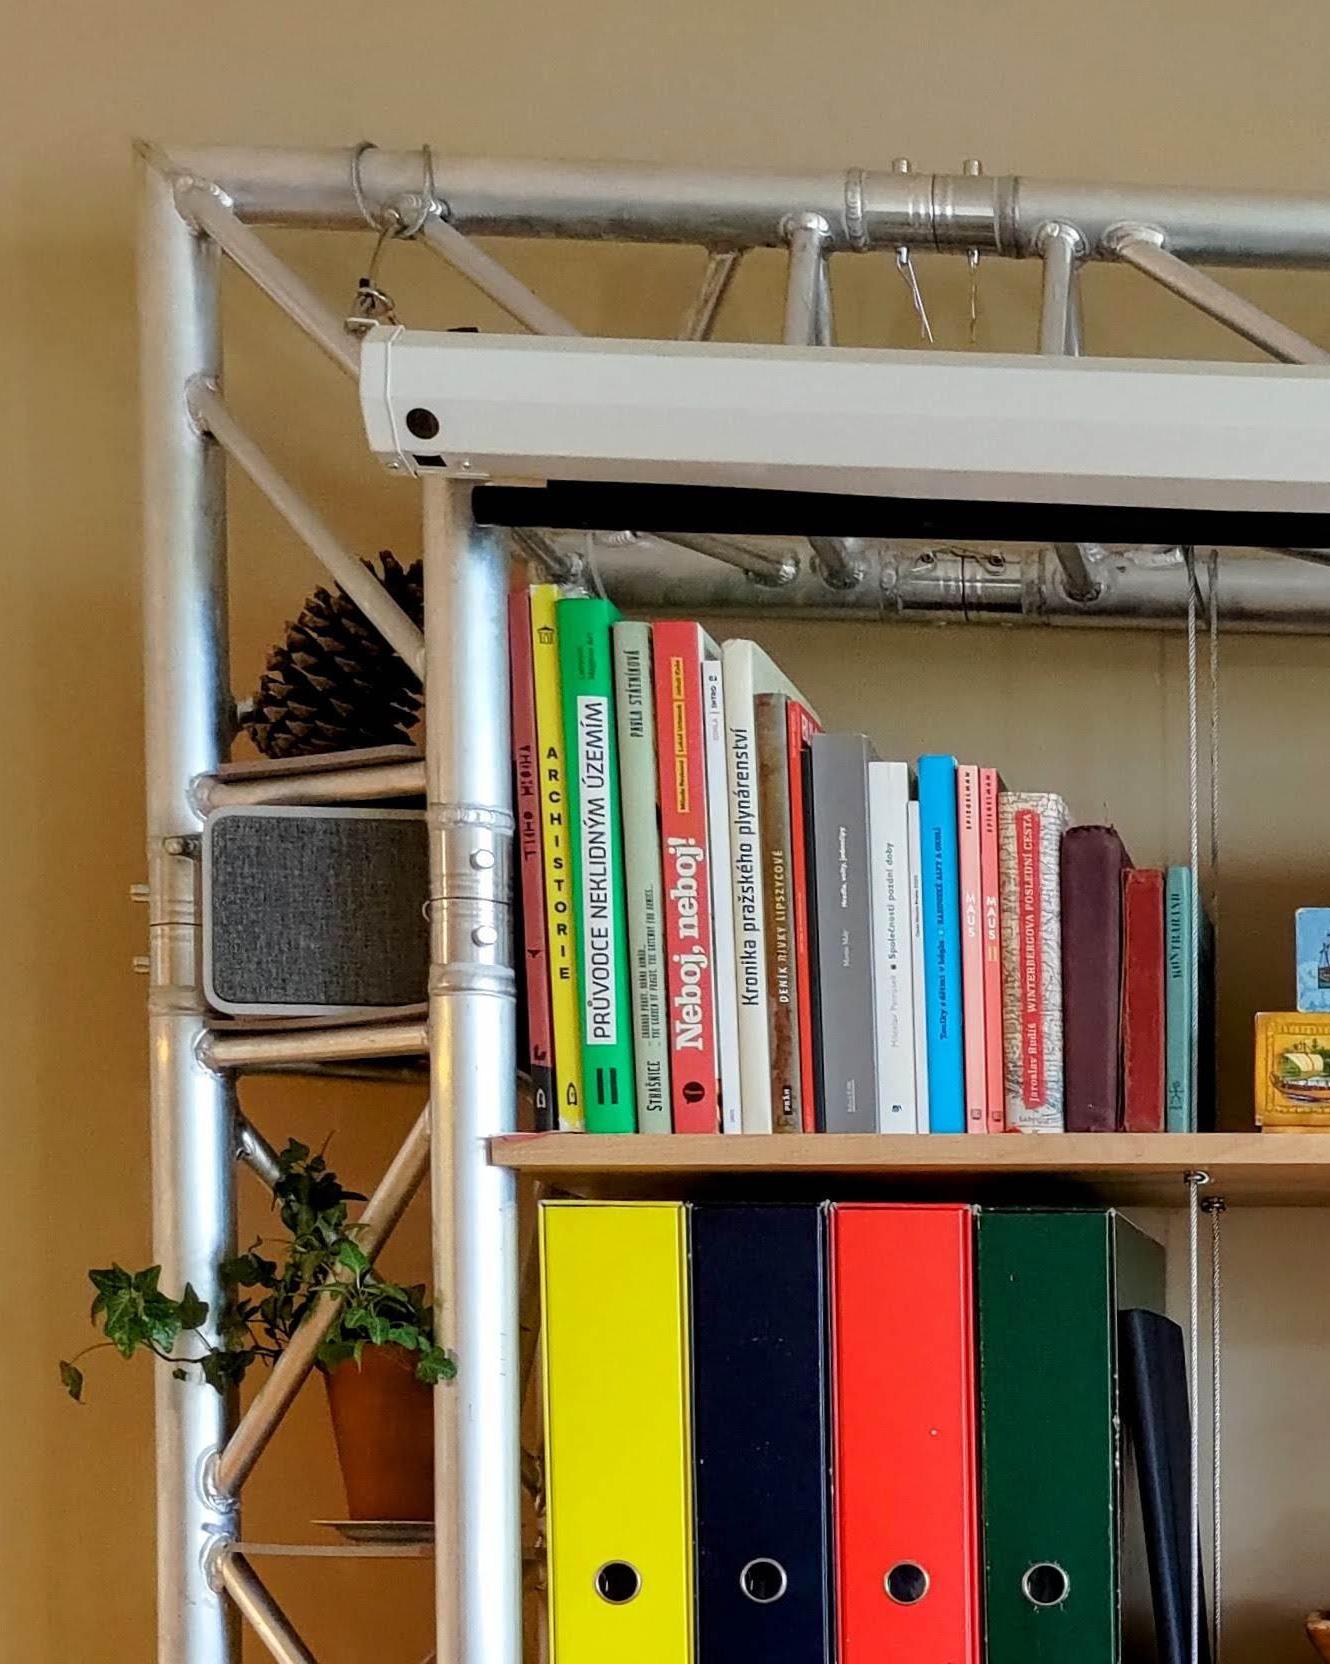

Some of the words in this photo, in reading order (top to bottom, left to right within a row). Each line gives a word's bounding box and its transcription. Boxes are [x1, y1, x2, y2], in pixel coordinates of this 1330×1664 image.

[580, 701, 605, 789] ÚZEMÍM
[730, 728, 757, 835] plynárenství
[546, 746, 570, 981] ARCHISTORIE
[585, 798, 609, 919] NEKLIDNÝM
[884, 843, 894, 866] doby
[1022, 813, 1033, 851] CESTA
[666, 837, 704, 940] neboj!
[735, 843, 759, 932] pražského
[771, 850, 787, 922] LIPSZYCOVÉ
[965, 893, 976, 938] MAUS
[1022, 852, 1034, 911] POSLEDNÍ
[587, 927, 612, 1039] PRŮVODCE
[672, 945, 708, 1051] Neboj,
[738, 940, 760, 1006] Kronika
[776, 967, 790, 1003] DENÍK
[1025, 913, 1037, 1013] WINTERBERGOVA
